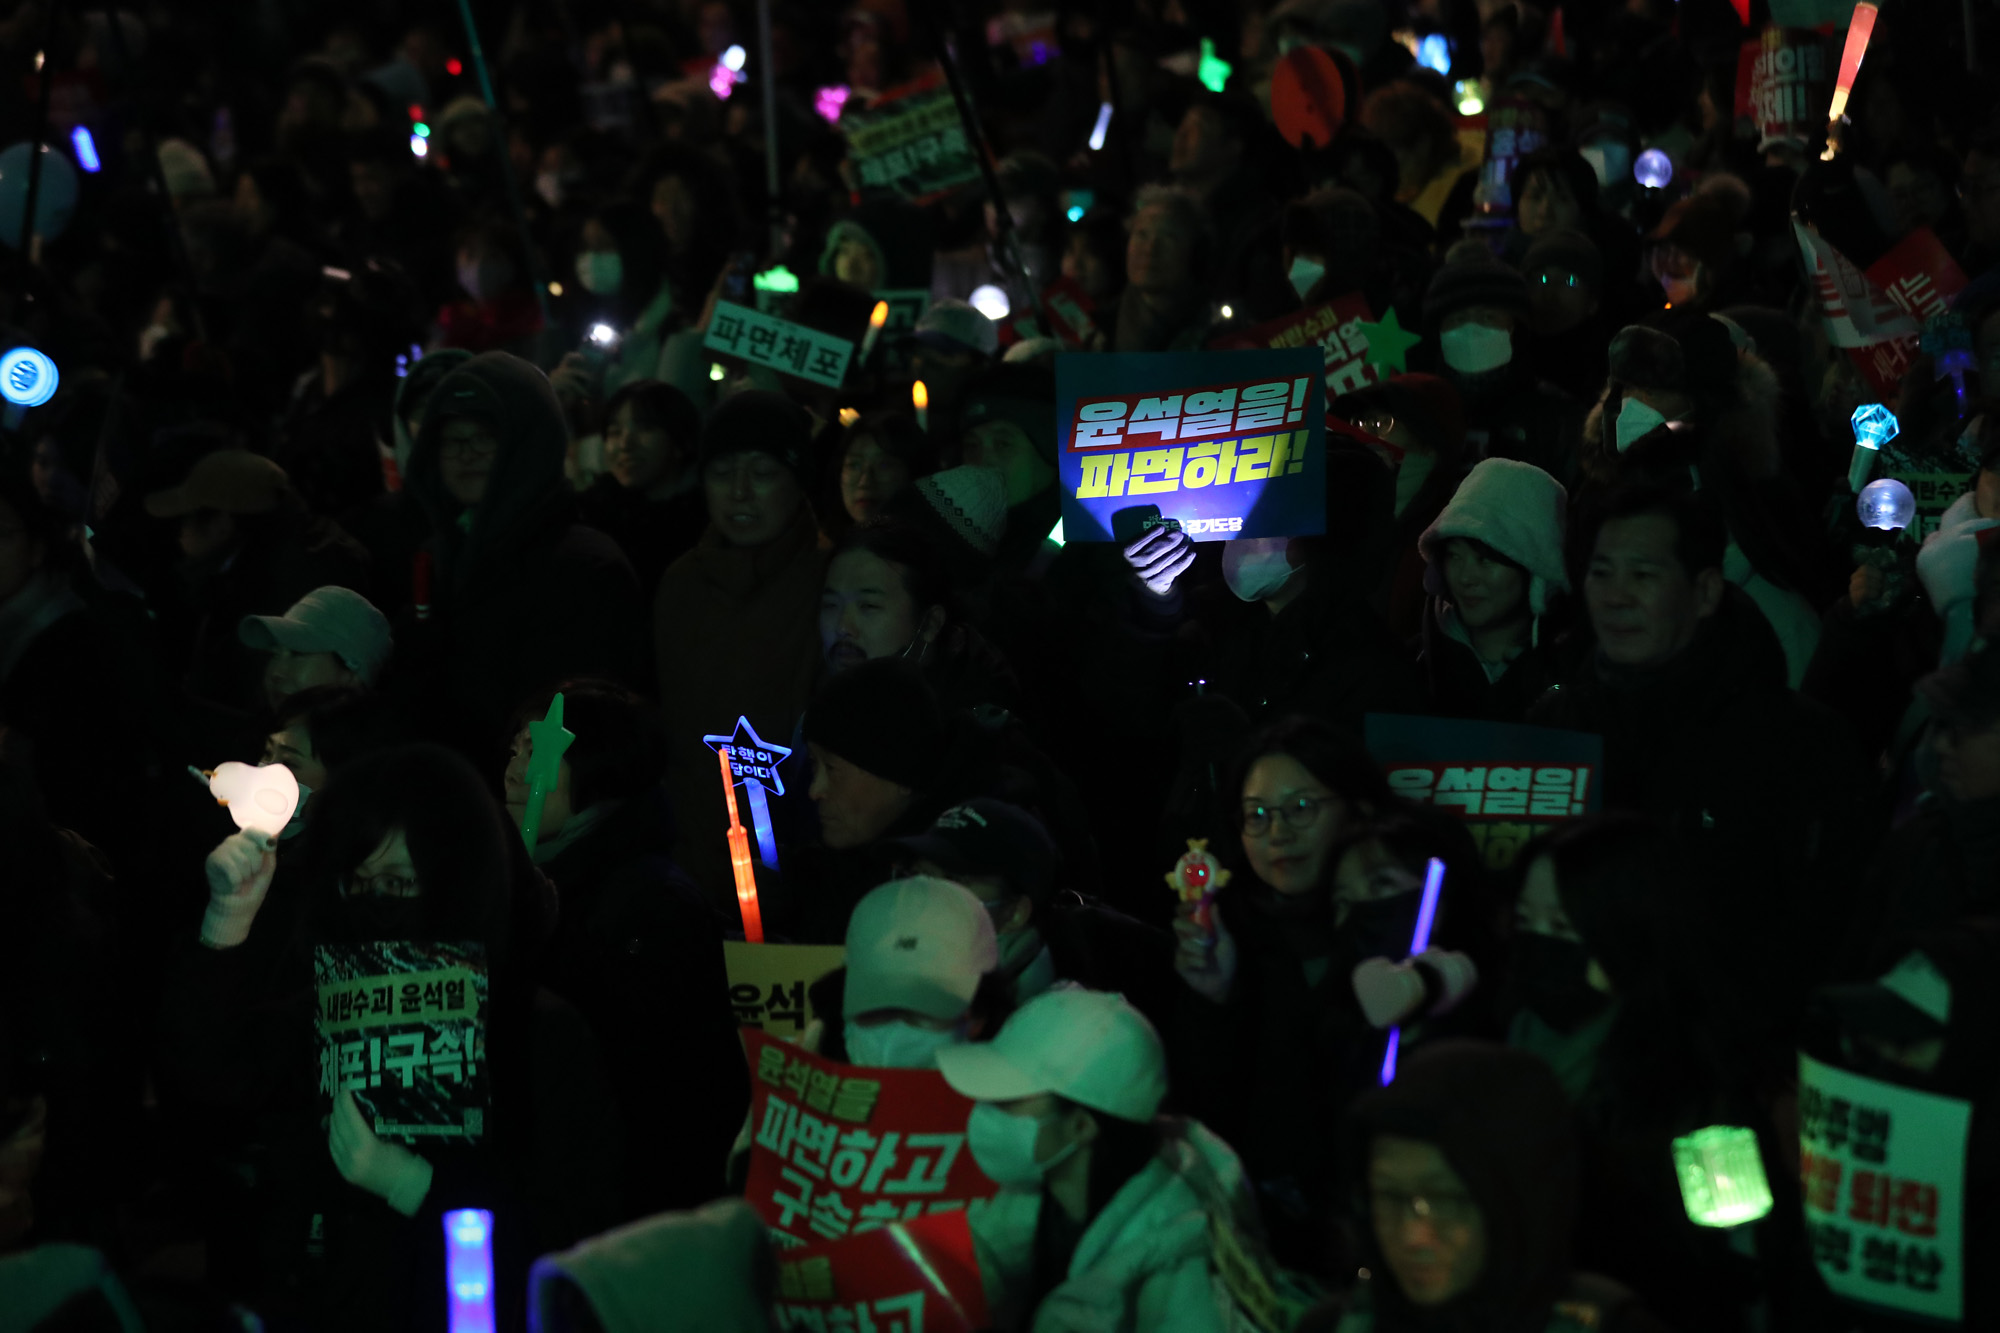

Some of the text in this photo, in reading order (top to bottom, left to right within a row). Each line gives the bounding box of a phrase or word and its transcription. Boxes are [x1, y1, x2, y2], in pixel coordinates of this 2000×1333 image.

[713, 315, 842, 380] 파면체포
[1074, 377, 1310, 448] 윤석열을!
[1075, 429, 1310, 499] 파면하라!
[1187, 517, 1244, 534] 경기도당
[729, 761, 772, 779] 답이다
[327, 979, 465, 1023] 내란수괴 윤석열
[729, 981, 805, 1030] 윤석
[758, 1044, 881, 1123] 윤석열을
[755, 1093, 967, 1193] 파면하고
